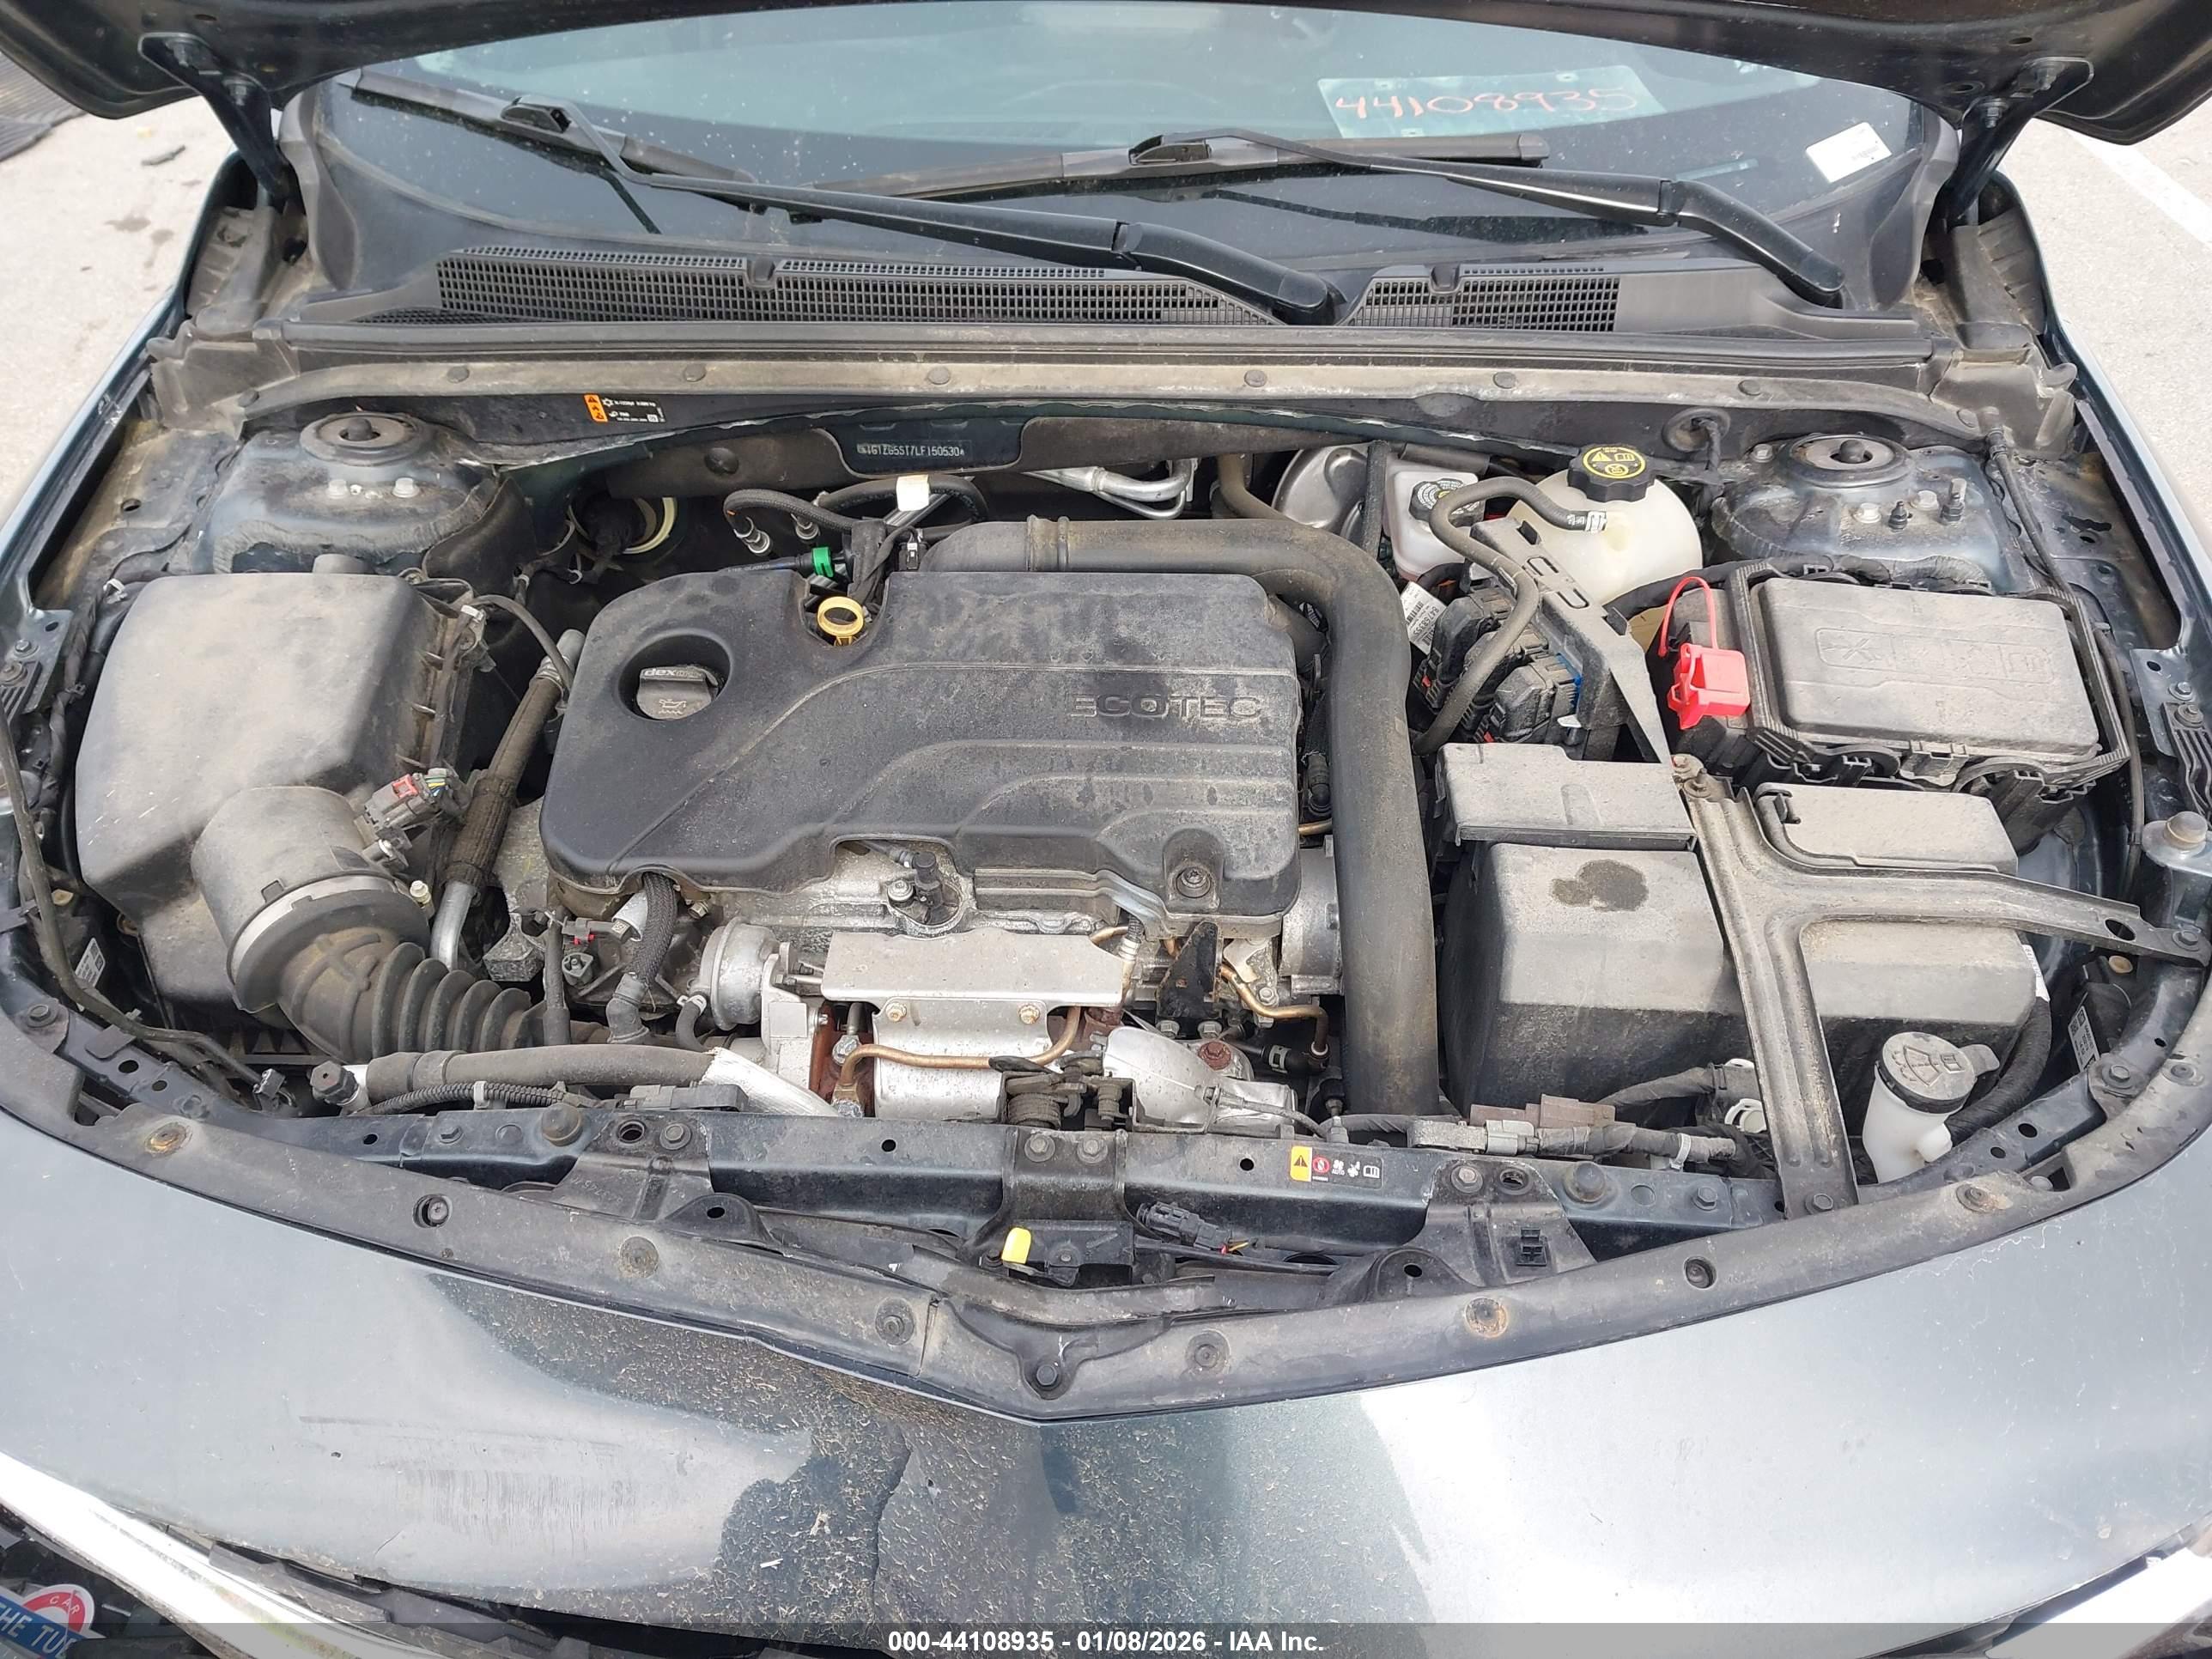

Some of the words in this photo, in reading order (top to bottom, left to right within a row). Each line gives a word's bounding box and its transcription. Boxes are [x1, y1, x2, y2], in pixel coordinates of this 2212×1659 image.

[1335, 88, 1637, 118] 44108935
[1069, 694, 1261, 719] ECOTEC
[49, 1595, 81, 1614] CAR
[0, 1602, 33, 1638] HE
